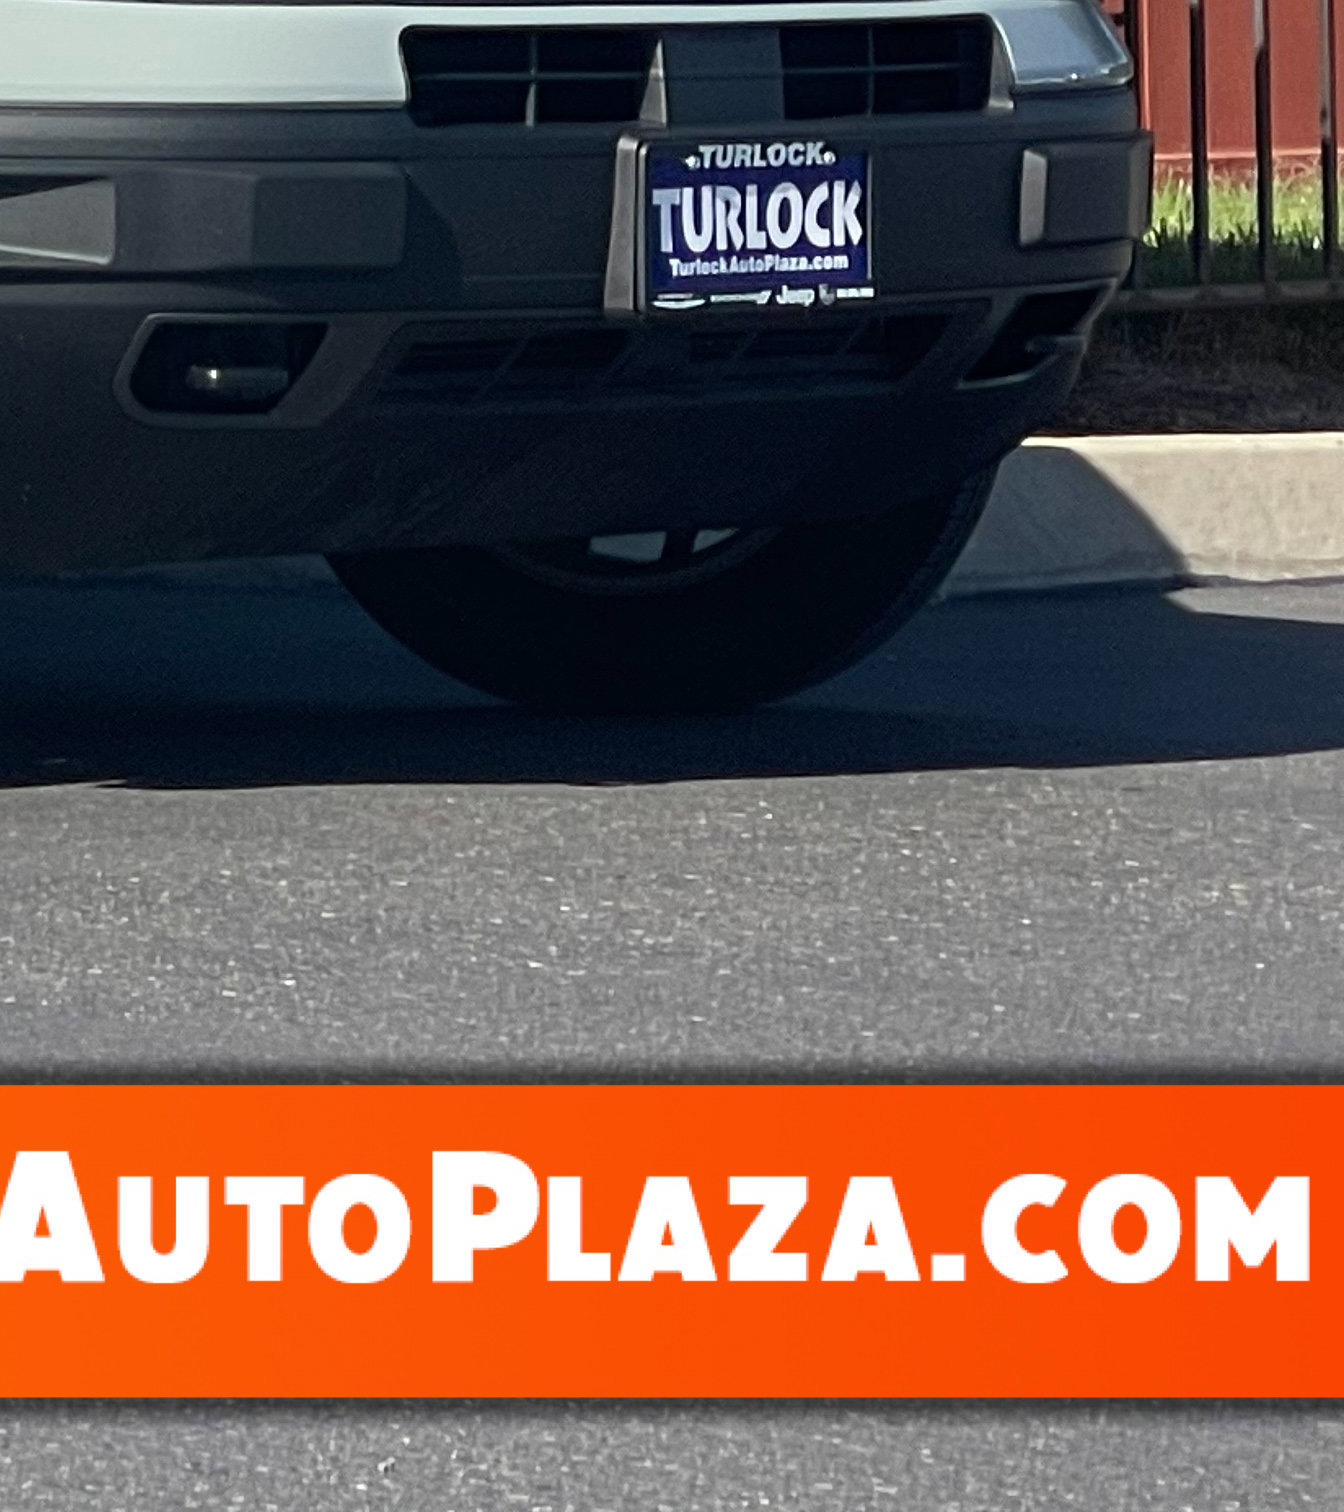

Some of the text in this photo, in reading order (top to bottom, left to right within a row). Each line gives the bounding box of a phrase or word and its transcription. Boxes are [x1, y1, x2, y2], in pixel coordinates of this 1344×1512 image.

[698, 141, 825, 169] TURLOCK
[652, 179, 863, 253] TURLOCK
[669, 254, 849, 277] TurlockAutoPlaza.com
